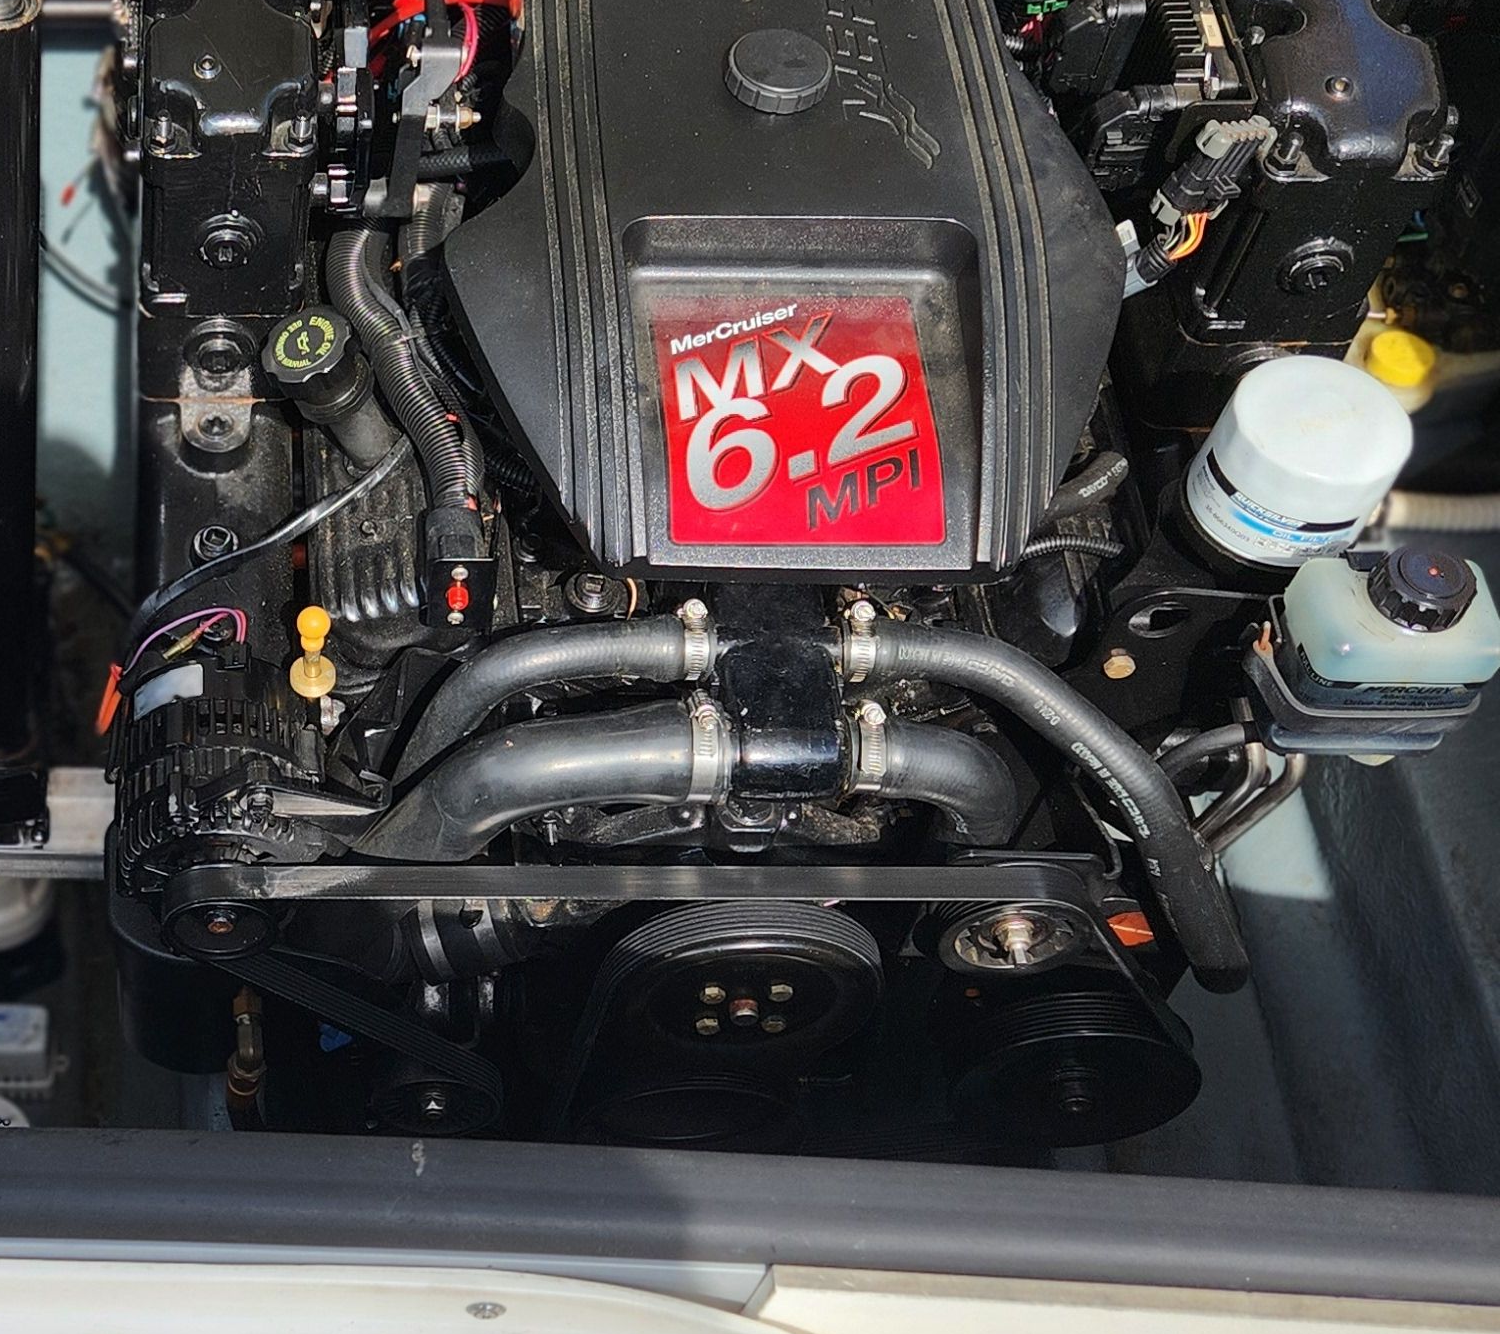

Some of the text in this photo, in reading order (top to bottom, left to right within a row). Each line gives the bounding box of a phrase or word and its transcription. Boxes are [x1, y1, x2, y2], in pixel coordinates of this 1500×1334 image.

[309, 316, 335, 342] ENGINE
[315, 341, 331, 356] OIL
[670, 302, 798, 356] MerCruiser
[674, 313, 842, 422] MX
[685, 354, 918, 513] 6.2
[806, 447, 922, 531] MPI
[1364, 686, 1454, 695] MERCURY
